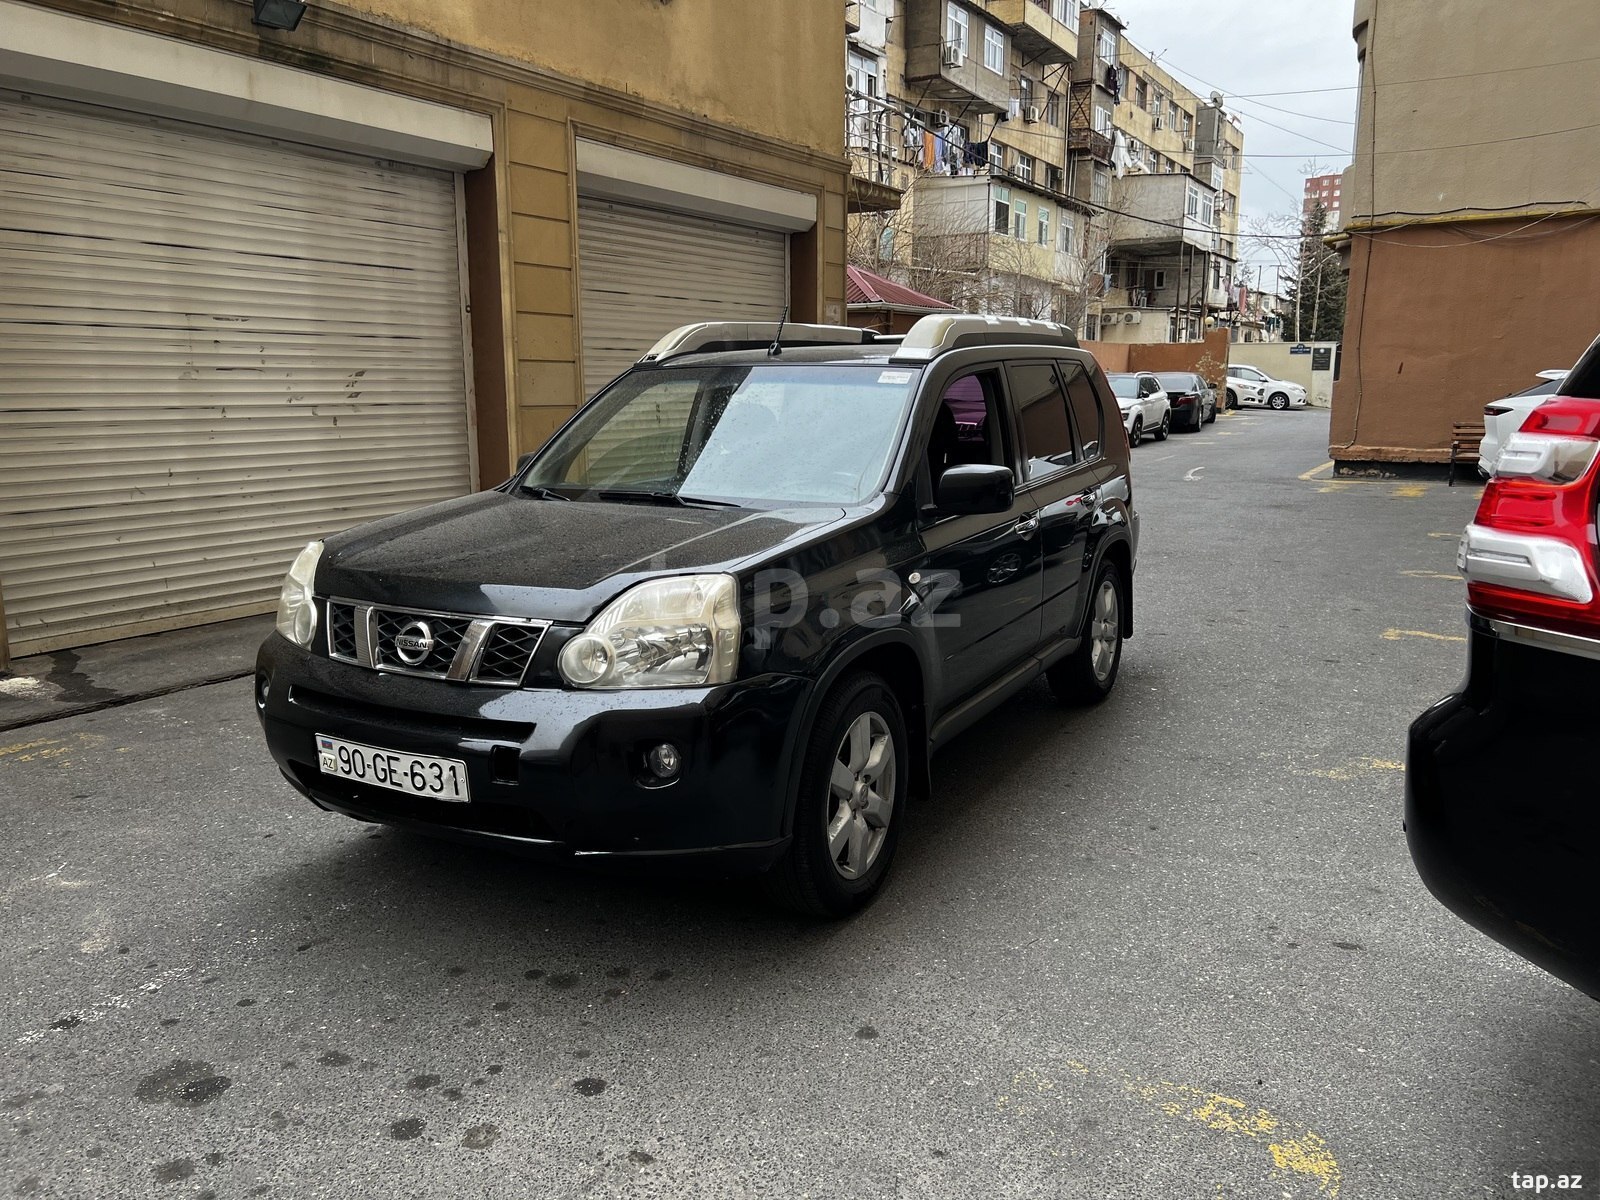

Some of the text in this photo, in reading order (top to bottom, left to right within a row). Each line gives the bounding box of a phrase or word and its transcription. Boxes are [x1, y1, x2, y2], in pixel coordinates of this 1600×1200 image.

[396, 638, 428, 649] NISSAN
[322, 757, 334, 769] AZ
[338, 745, 460, 796] 90-GE-631
